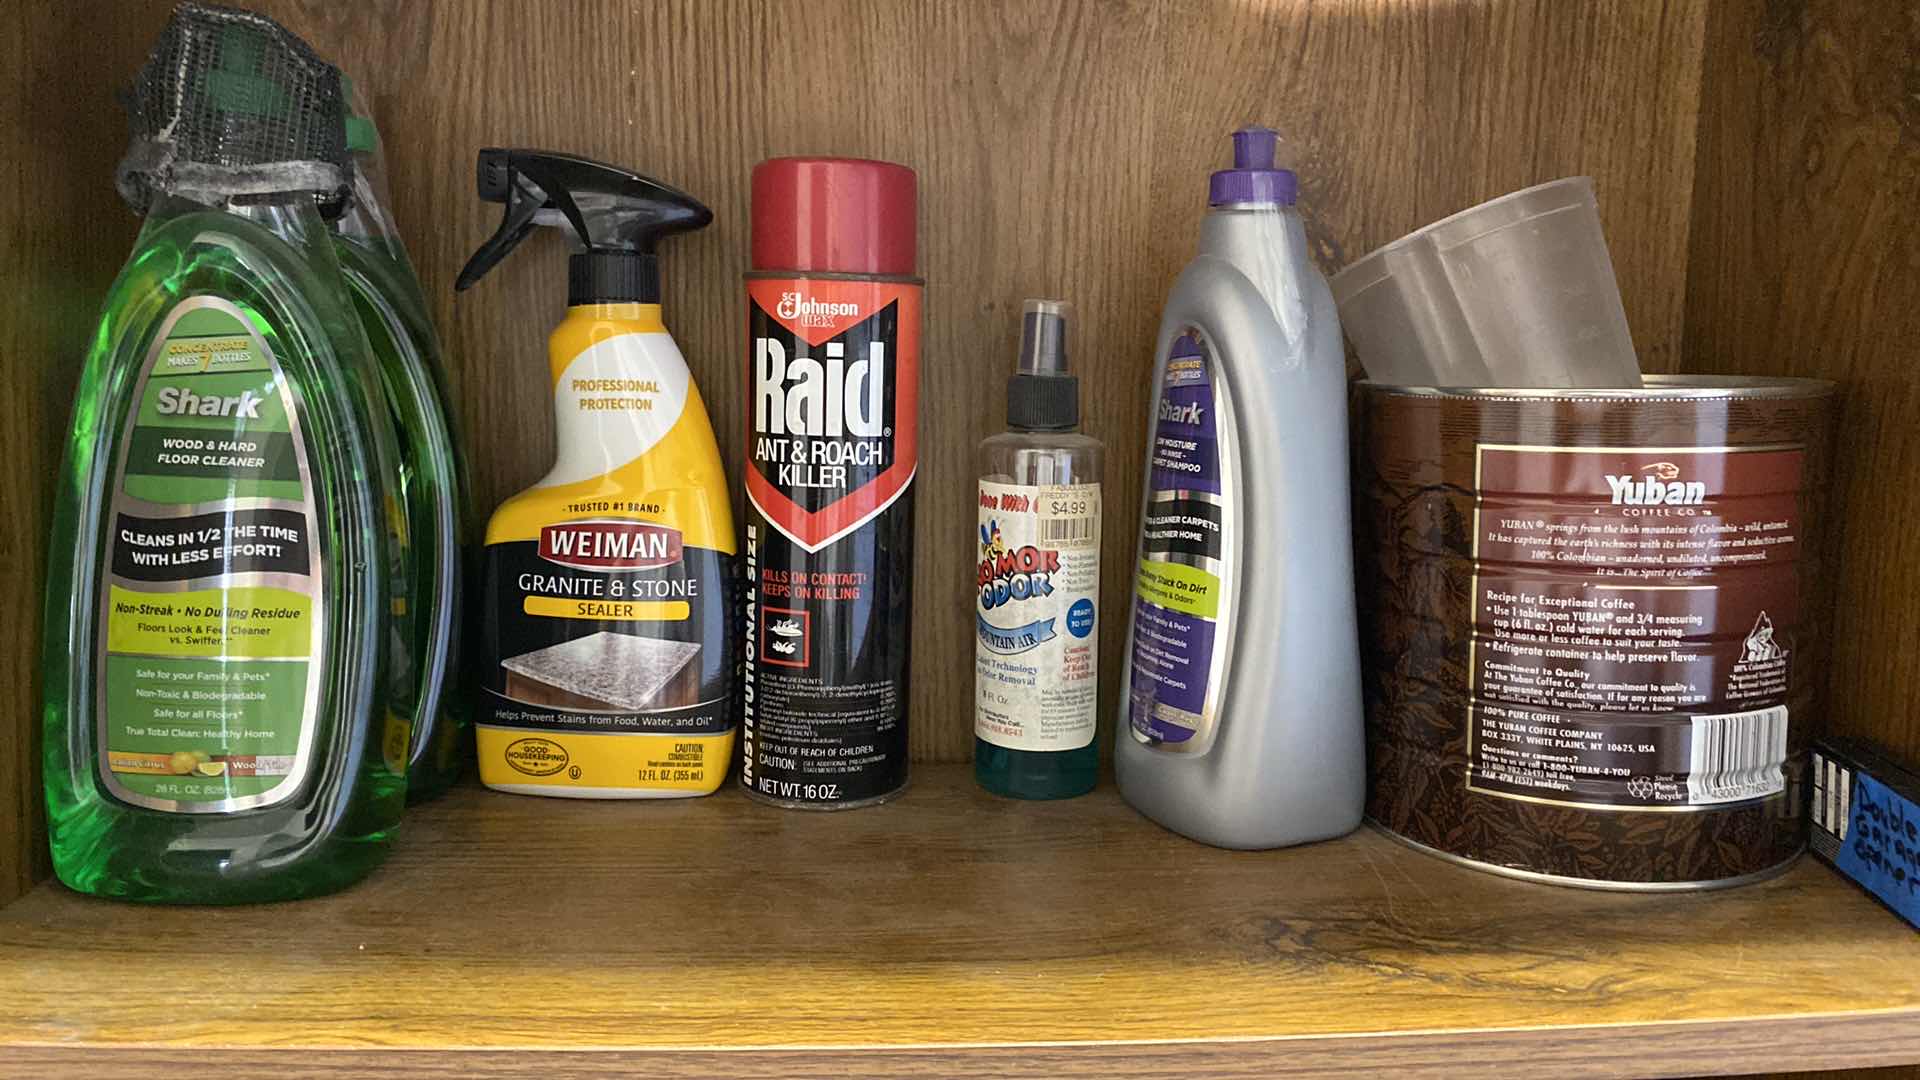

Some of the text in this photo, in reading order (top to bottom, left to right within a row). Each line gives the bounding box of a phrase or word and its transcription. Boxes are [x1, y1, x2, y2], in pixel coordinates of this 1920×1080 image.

[776, 292, 858, 319] Johnson
[167, 356, 198, 367] MAKES
[200, 352, 211, 373] 7
[572, 379, 660, 393] PROFESSIONAL
[756, 338, 884, 436] Raid
[158, 387, 264, 418] Shark
[579, 398, 653, 410] PROTECTION
[1160, 398, 1203, 425] Shark
[163, 439, 257, 452] WOOD & HARD
[755, 438, 882, 465] ANT & ROACH
[158, 454, 265, 468] FLOOR CLEANER
[1166, 459, 1200, 473] SHAMPOO
[779, 464, 846, 488] KILLER
[1604, 474, 1706, 505] Yuban
[569, 502, 660, 514] TRUSTED #1 BRAND
[1052, 501, 1086, 515] $4.99
[1182, 516, 1219, 532] CARPETS
[121, 525, 299, 547] CLEANS IN 1/2 THE TIME
[549, 529, 668, 559] WEIMAN
[1179, 530, 1203, 542] HOME
[132, 544, 281, 565] WITH LESS EFFORT!
[978, 558, 994, 585] O
[995, 545, 1061, 578] MOR
[518, 573, 698, 597] GRANITE & STONE
[762, 568, 867, 586] KILLS ON CONTACT!
[1156, 576, 1207, 595] Stuck On Dirt
[762, 582, 860, 600] KEEPS ON KILLING
[981, 573, 1055, 610] ODOR
[1487, 590, 1635, 610] Recipe for Exceptional Coffee
[115, 602, 300, 619] Non-Streak No Duling Residue
[578, 602, 633, 617] SEALER
[1494, 606, 1509, 616] Use
[1512, 608, 1517, 617] 1
[1518, 608, 1569, 621] tablespoon
[1616, 614, 1633, 623] and
[1637, 614, 1653, 624] 3/4
[1656, 616, 1703, 627] measuring
[137, 623, 270, 636] Floors Look & Fee Cleaner
[1018, 633, 1037, 648] AIR
[744, 524, 757, 786] INSTITUTIONAL SIZE
[1493, 641, 1700, 664] Refrigerate container to help preserve flavor.
[136, 669, 155, 679] Safe
[158, 670, 171, 679] for
[173, 672, 194, 682] your
[197, 672, 230, 682] Family
[233, 672, 241, 680] &
[992, 660, 1037, 674] Technology
[1484, 660, 1590, 680] Commitment to Quality
[999, 673, 1036, 685] Removal
[136, 689, 266, 702] Non-Toxic & Biodegradable
[153, 709, 174, 718] Safe
[176, 709, 189, 719] for
[192, 710, 204, 719] all
[496, 709, 519, 722] Helps
[521, 712, 555, 723] Prevent
[557, 714, 587, 725] Stains
[589, 715, 612, 725] from
[614, 716, 640, 726] Food,
[642, 716, 673, 727] Water,
[676, 716, 694, 726] and
[126, 726, 145, 736] True
[147, 727, 169, 737] Total
[203, 729, 242, 739] Healthy
[244, 729, 275, 738] Home
[1482, 719, 1604, 740] THE YUBAN COFFEE COMPANY
[508, 752, 566, 762] HOUSEKEEPING
[524, 745, 548, 754] GOOD
[775, 745, 788, 754] OUT
[790, 747, 798, 755] OF
[801, 748, 825, 757] REACH
[828, 748, 836, 756] OF
[840, 745, 874, 756] CHILDREN
[638, 770, 646, 780] 12
[648, 770, 659, 780] FL.
[661, 770, 671, 781] OZ.
[673, 770, 689, 781] (355
[759, 777, 839, 799] NET WT. 16 OZ.
